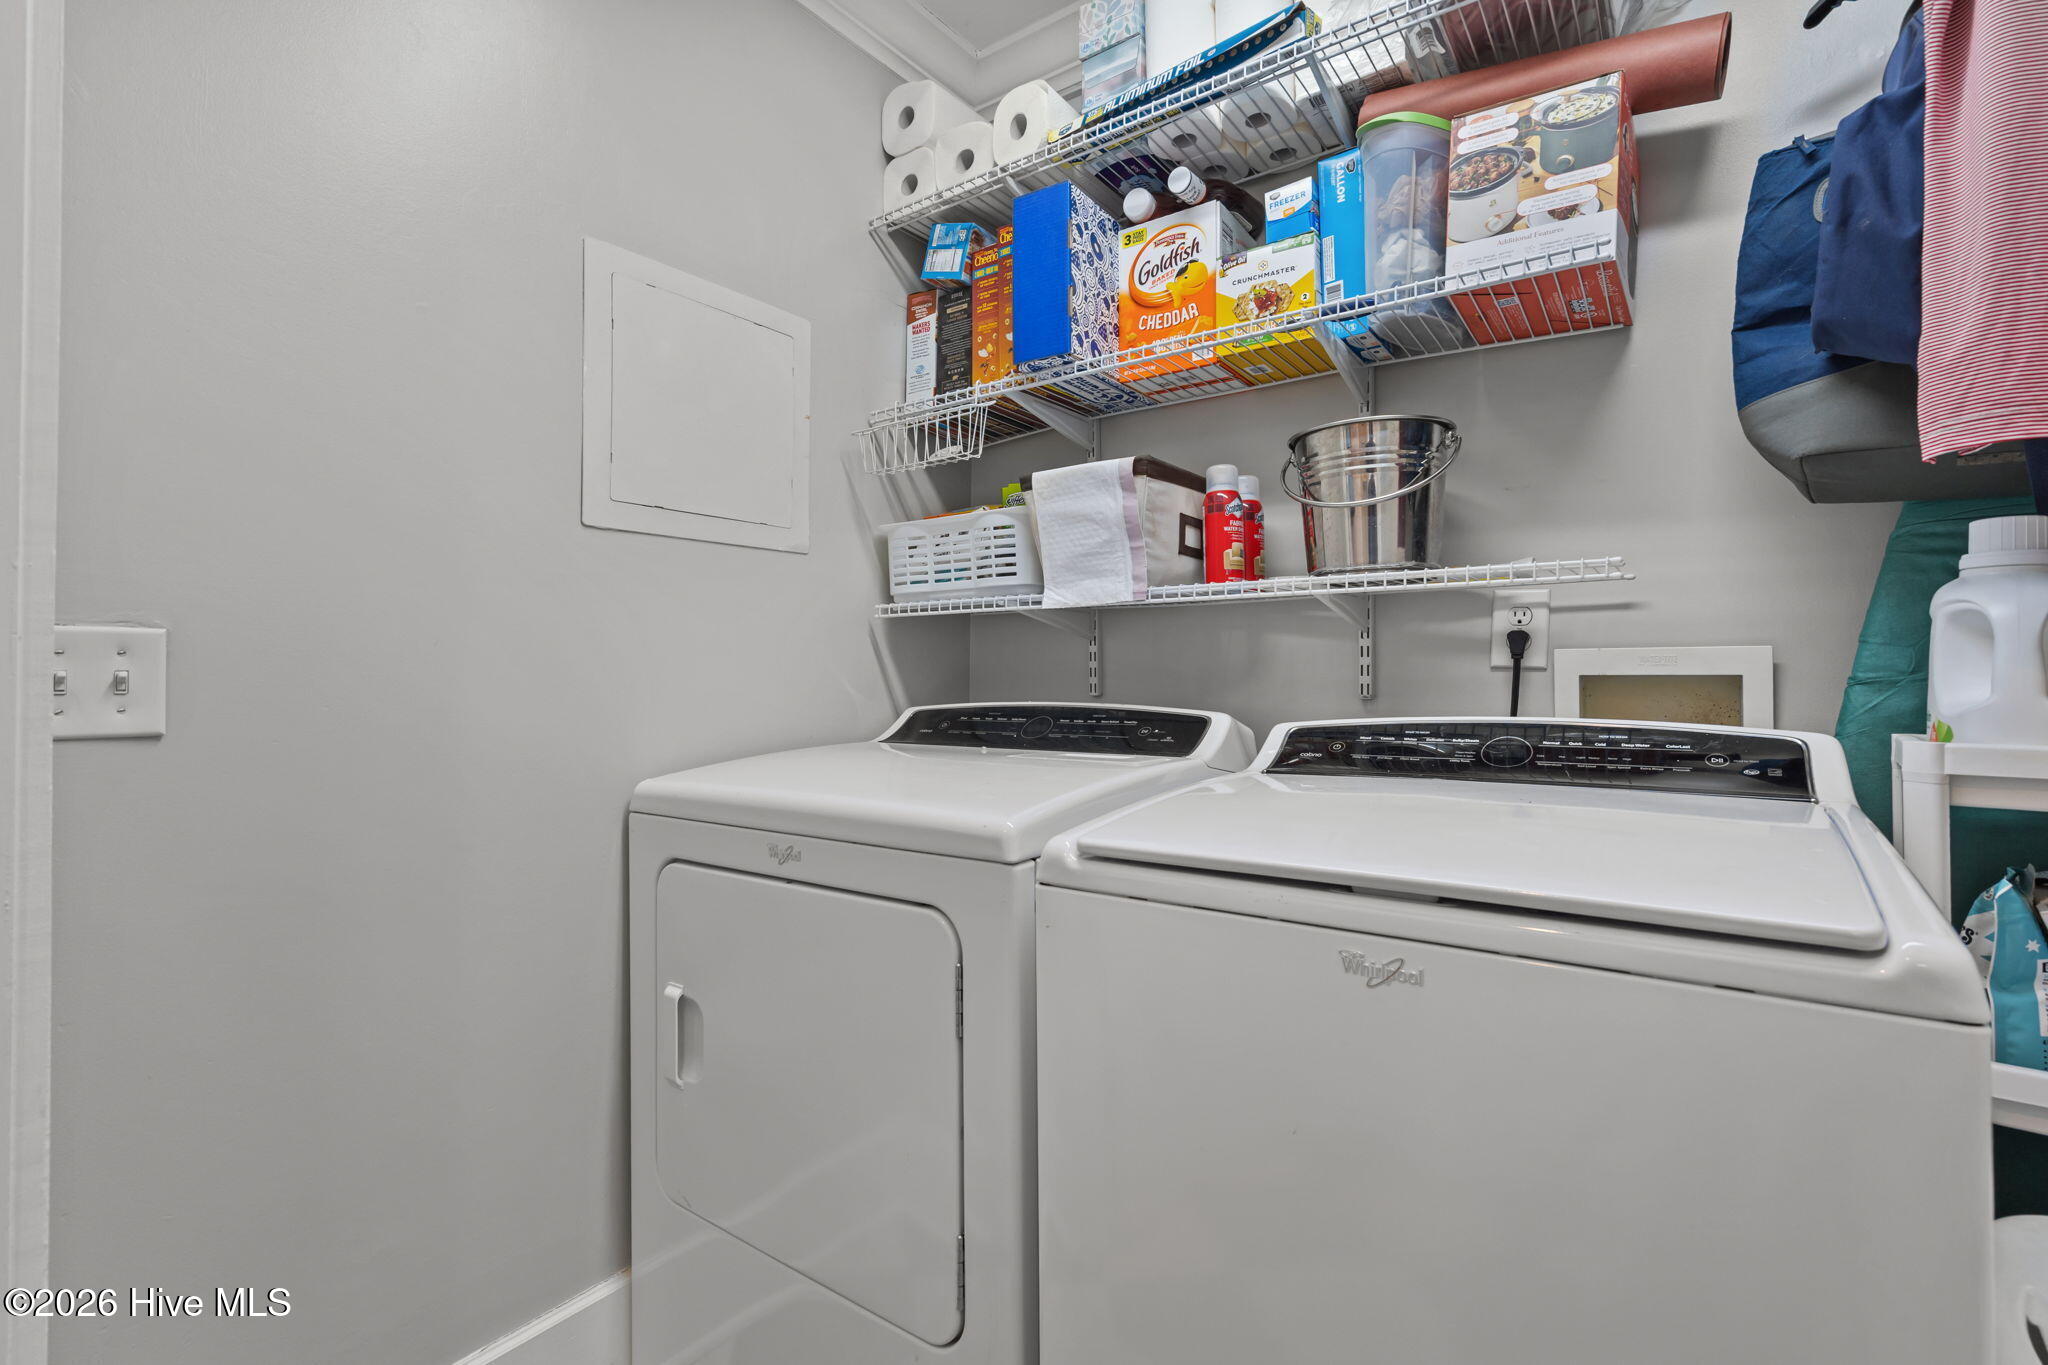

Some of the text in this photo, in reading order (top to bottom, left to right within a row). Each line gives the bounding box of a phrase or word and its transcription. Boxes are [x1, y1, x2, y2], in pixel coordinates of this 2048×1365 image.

[1103, 69, 1174, 114] ALUMINUM
[1174, 53, 1205, 78] FOIL
[1335, 161, 1347, 203] GALLON
[1269, 190, 1306, 210] FREEZER
[1124, 234, 1132, 246] 3
[1496, 226, 1565, 246] Additional Features
[1138, 237, 1200, 286] Goldfish
[1232, 265, 1296, 286] CRUNCHMASTER
[1138, 302, 1199, 330] CHEDDAR
[1338, 949, 1425, 989] Whirlpool
